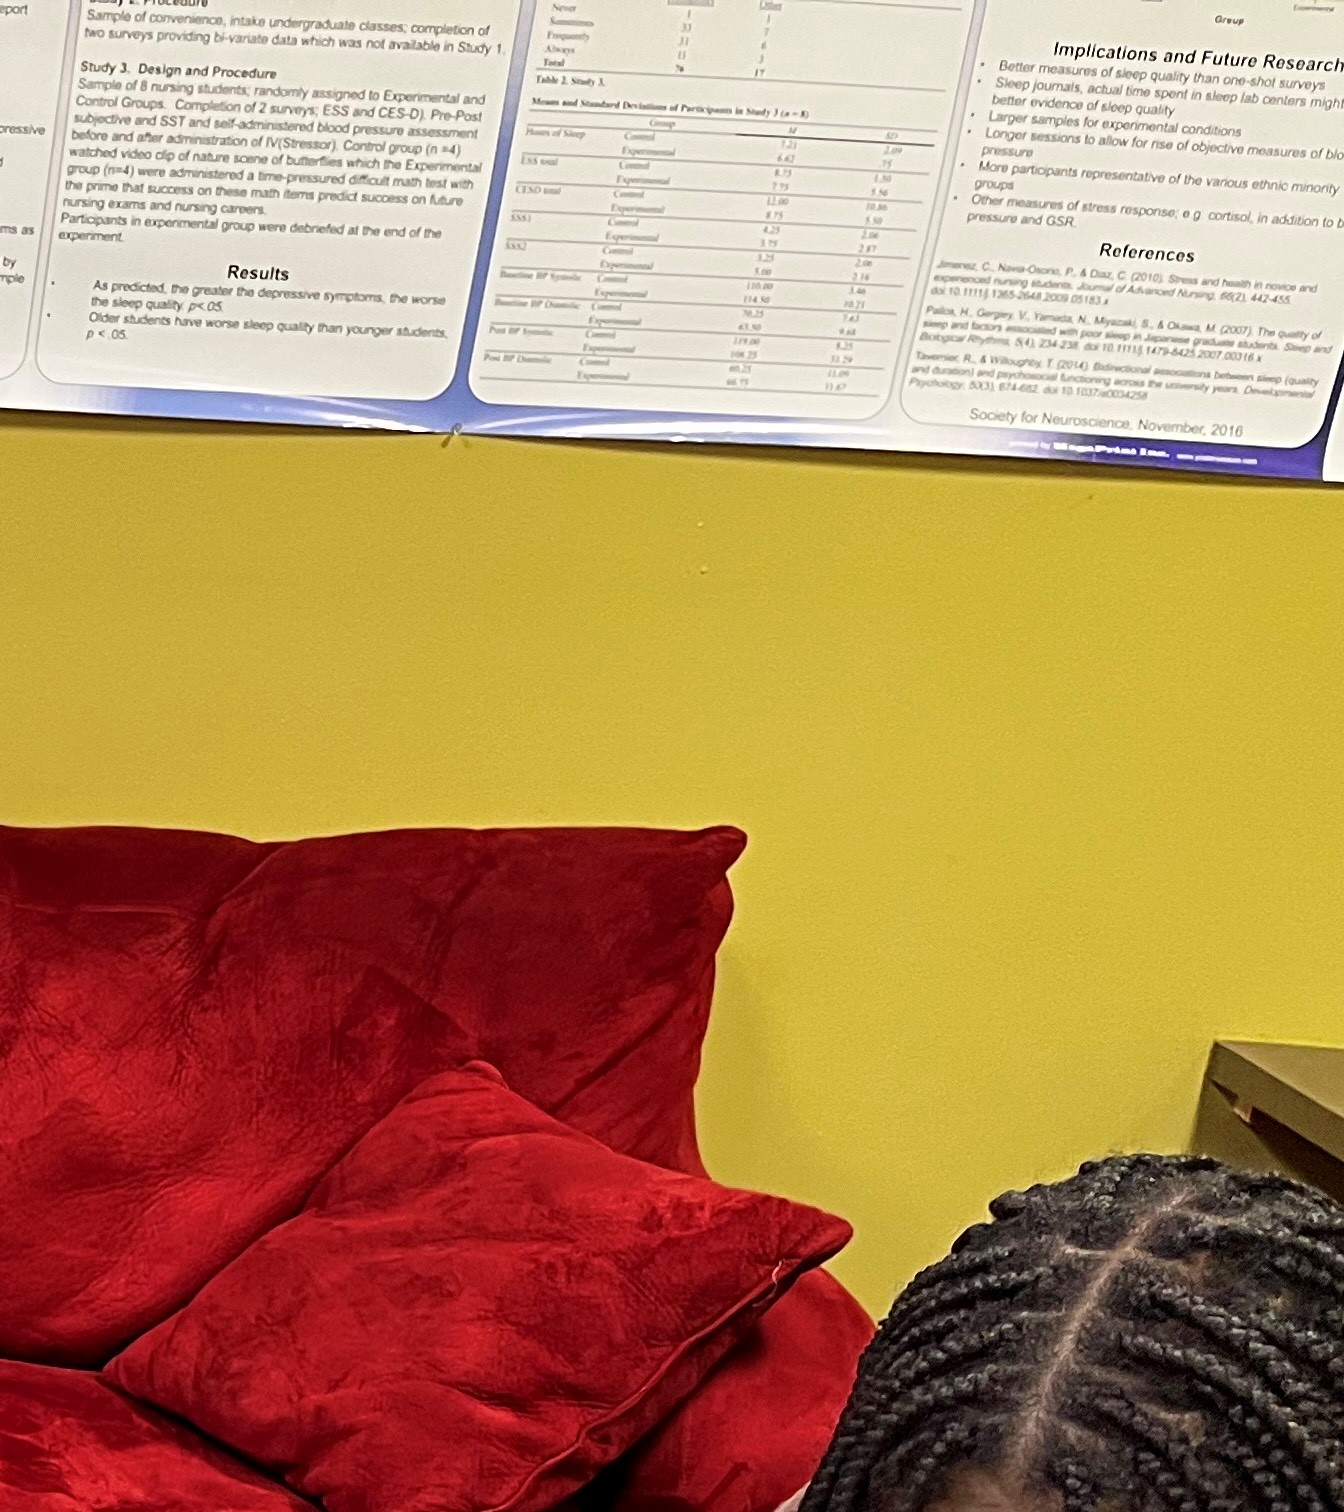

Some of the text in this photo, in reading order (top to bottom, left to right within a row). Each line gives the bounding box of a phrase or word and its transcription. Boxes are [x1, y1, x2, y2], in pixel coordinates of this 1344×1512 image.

[1052, 40, 1344, 73] Implications and Future Research
[997, 58, 1326, 94] Better measures of sleep quality than one-shot surveys
[990, 93, 1176, 120] better evidence of sleep quality
[994, 75, 1031, 93] Sleep
[1085, 83, 1124, 96] actual
[1124, 84, 1152, 98] time
[1153, 87, 1189, 101] spent
[1189, 90, 1203, 101] in
[1204, 88, 1239, 105] sleep
[1238, 90, 1260, 105] lab
[1261, 94, 1308, 108] centers
[1308, 96, 1344, 112] might
[987, 108, 1243, 138] Larger samples for experimental conditions
[1098, 241, 1195, 264] References
[226, 263, 290, 282] Results
[968, 406, 1244, 438] Society for Neuroscience, November, 2016
